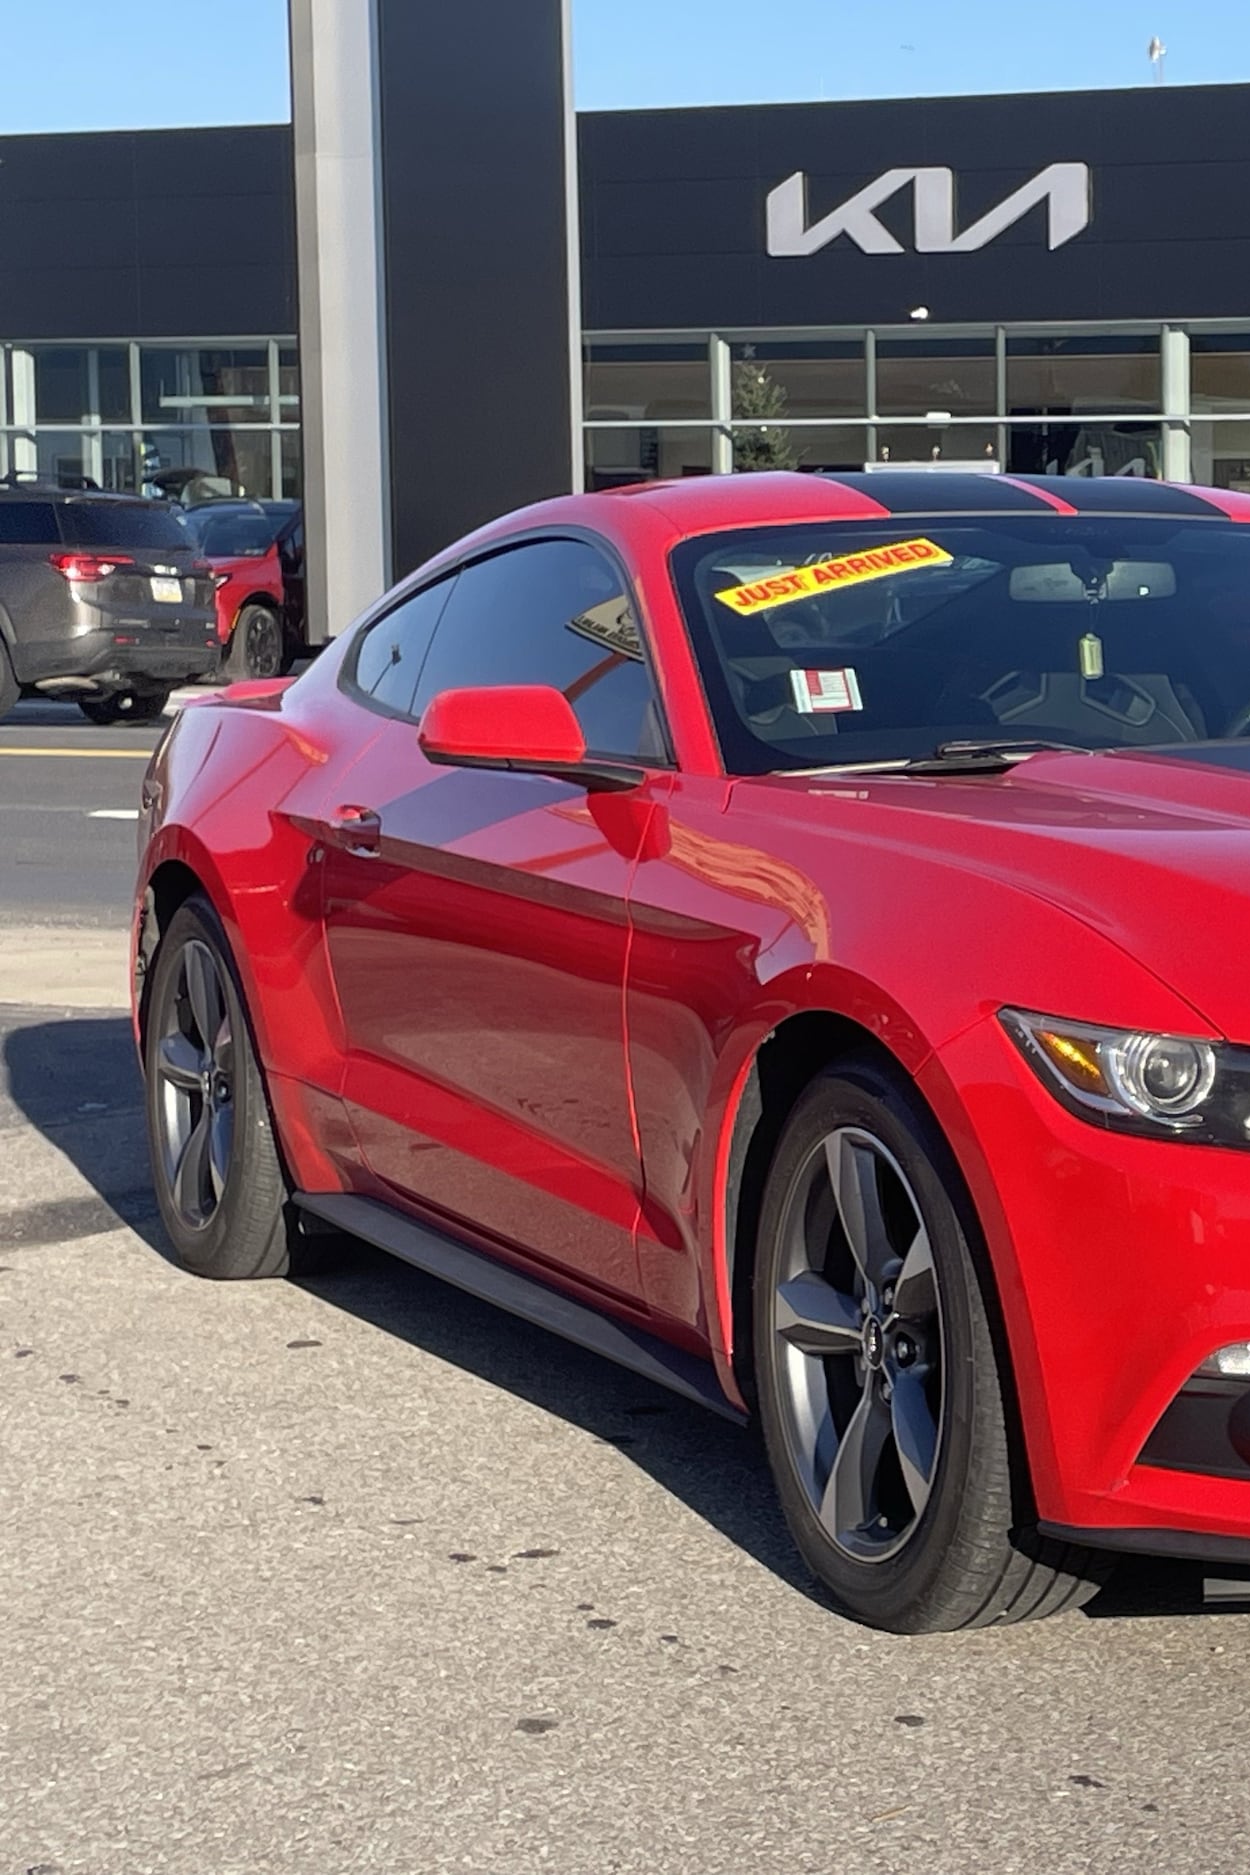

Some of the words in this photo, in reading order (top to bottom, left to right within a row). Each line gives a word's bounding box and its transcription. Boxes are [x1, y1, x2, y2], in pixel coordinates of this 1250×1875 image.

[766, 162, 1088, 257] KIA
[735, 574, 806, 608] JUST
[812, 543, 938, 585] ARRIVED
